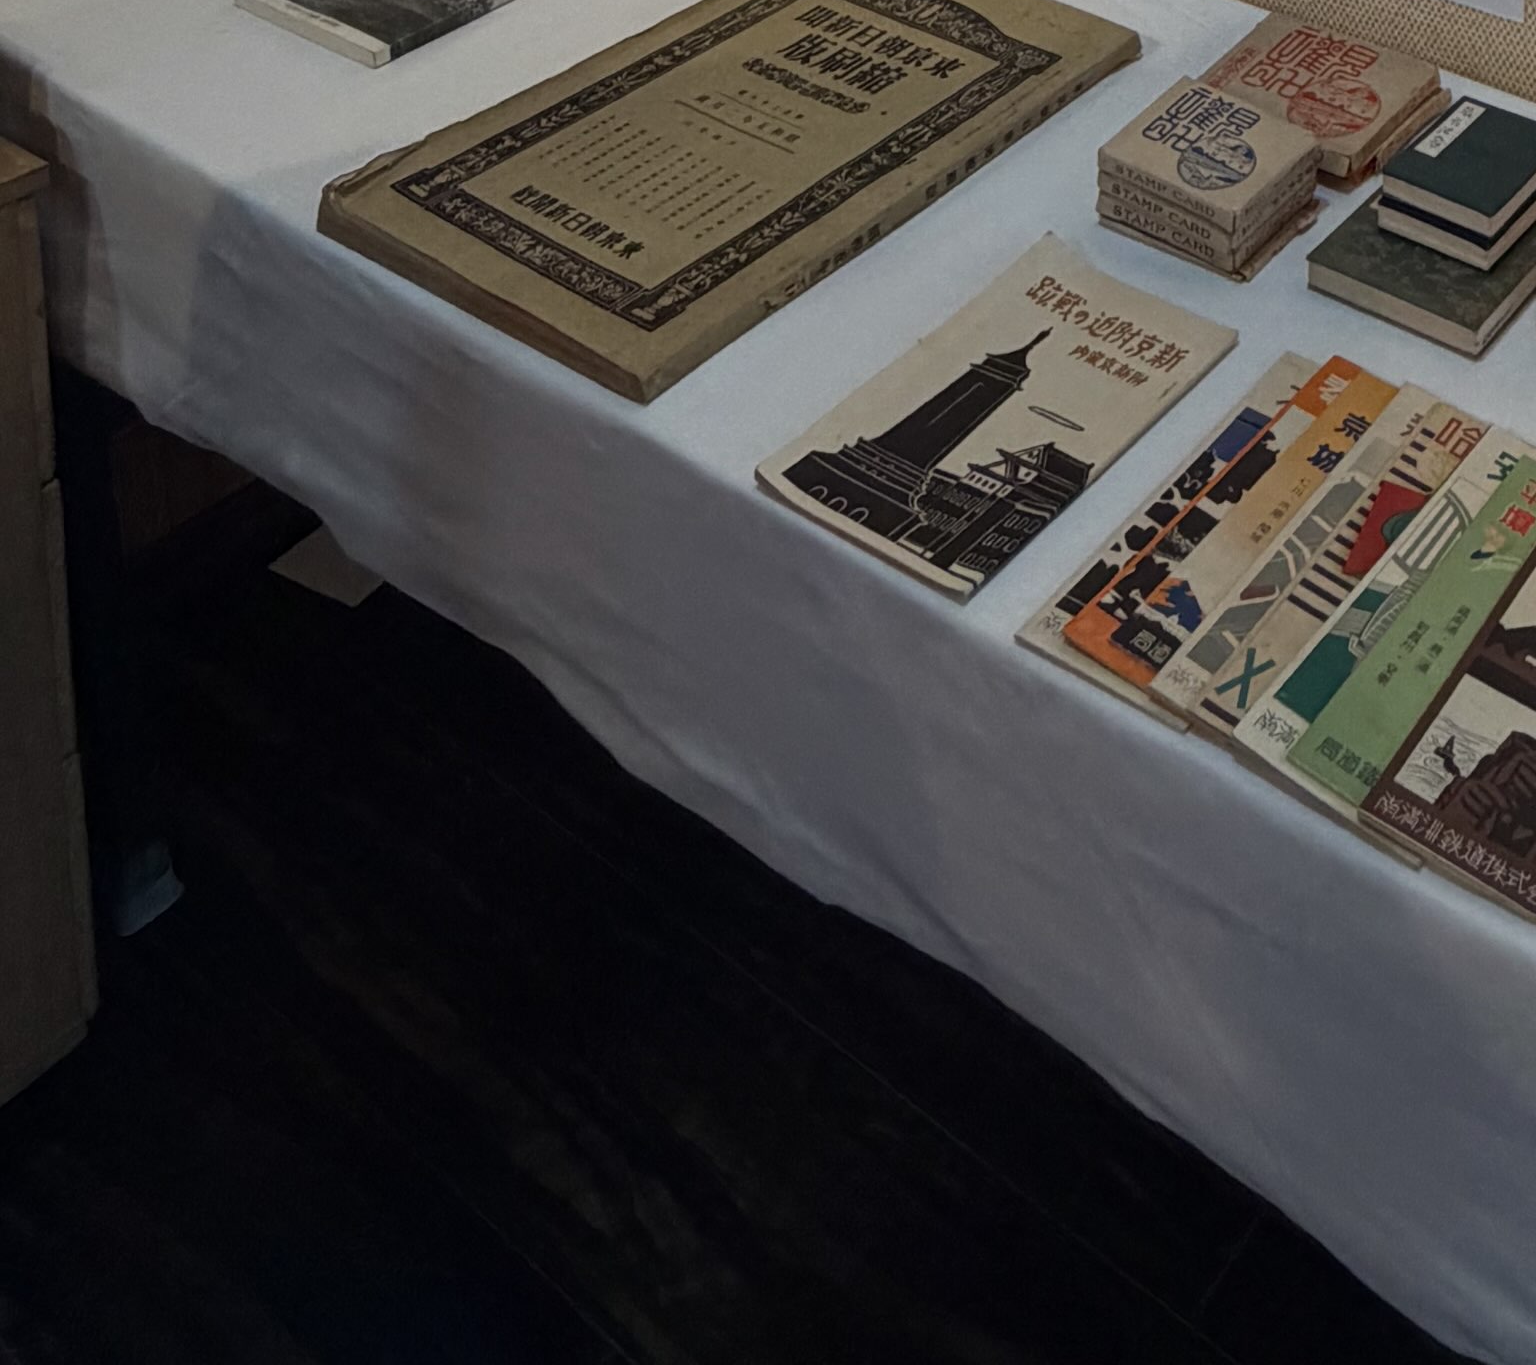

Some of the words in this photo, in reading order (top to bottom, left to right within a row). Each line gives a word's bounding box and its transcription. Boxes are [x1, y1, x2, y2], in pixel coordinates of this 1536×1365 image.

[1115, 164, 1168, 192] STAMP
[1111, 183, 1164, 213] STAMP
[1168, 211, 1211, 240] CARD
[1113, 205, 1166, 234] STAMP
[1171, 231, 1215, 258] CARD
